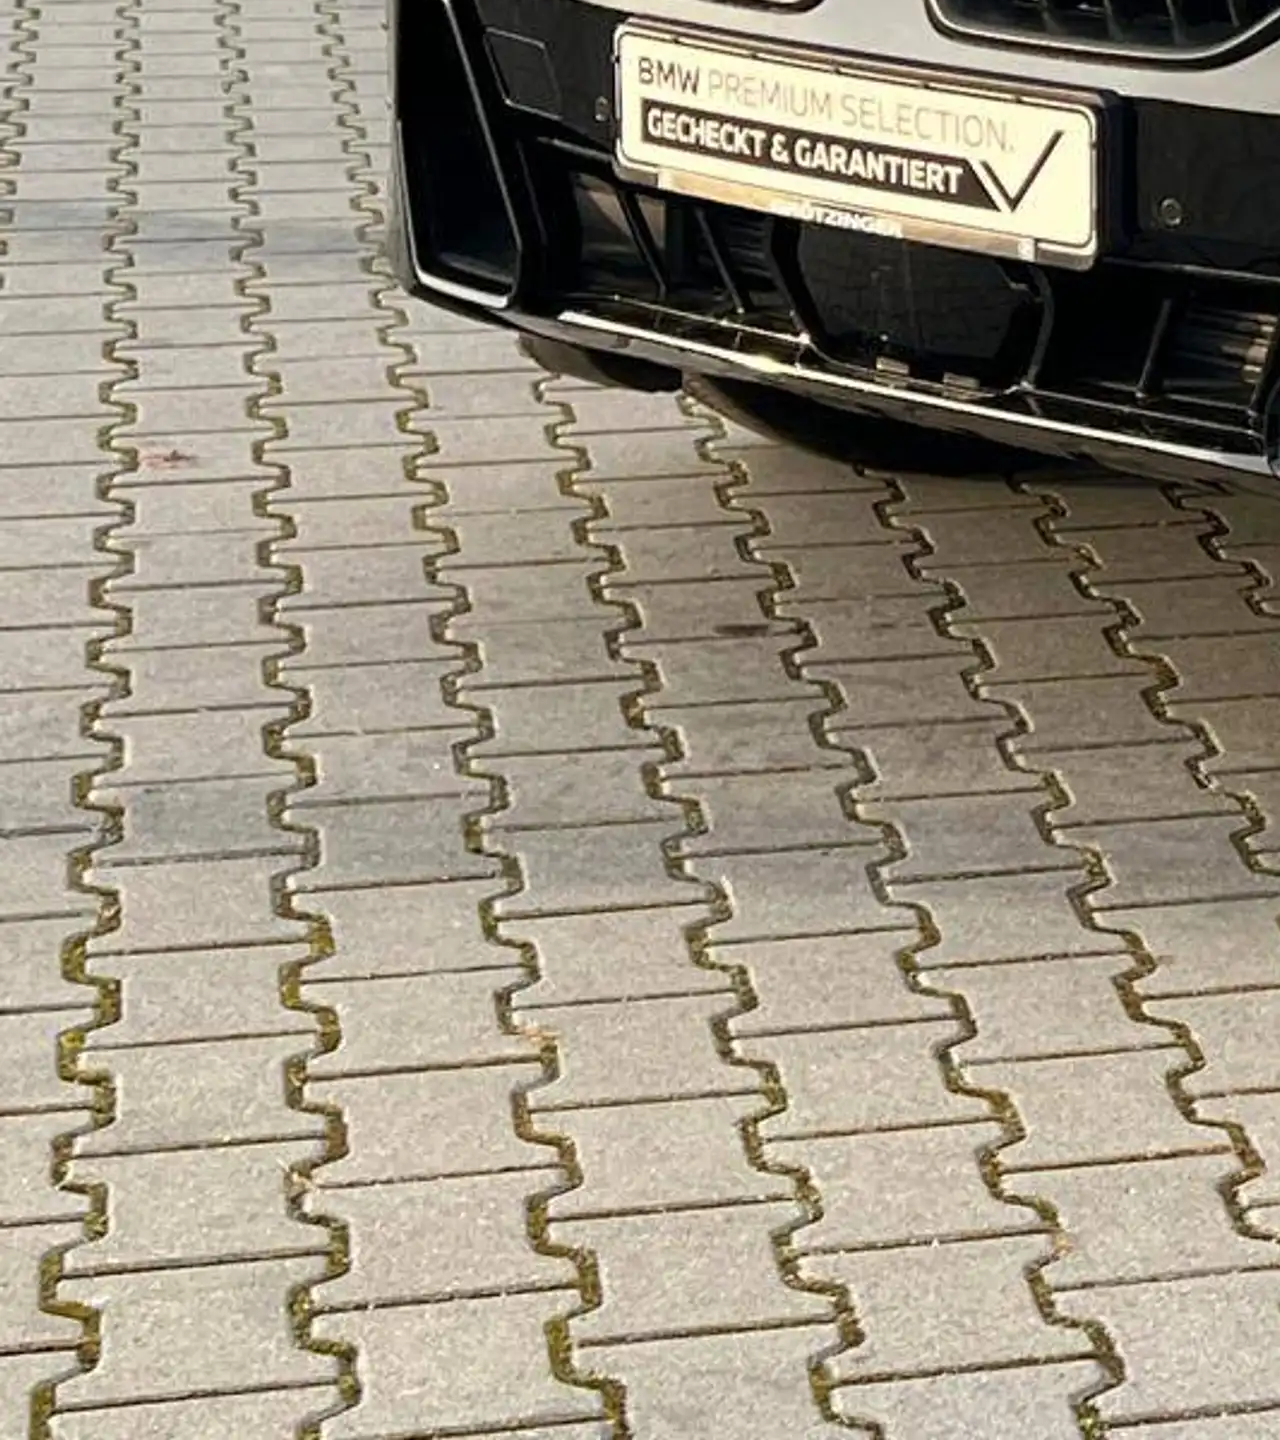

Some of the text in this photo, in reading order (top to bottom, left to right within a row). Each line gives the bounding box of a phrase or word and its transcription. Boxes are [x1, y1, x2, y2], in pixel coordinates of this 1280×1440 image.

[638, 55, 1014, 153] BMW PREMIUM SELECTION.
[647, 106, 964, 195] GECHECKT & GARANTIERT
